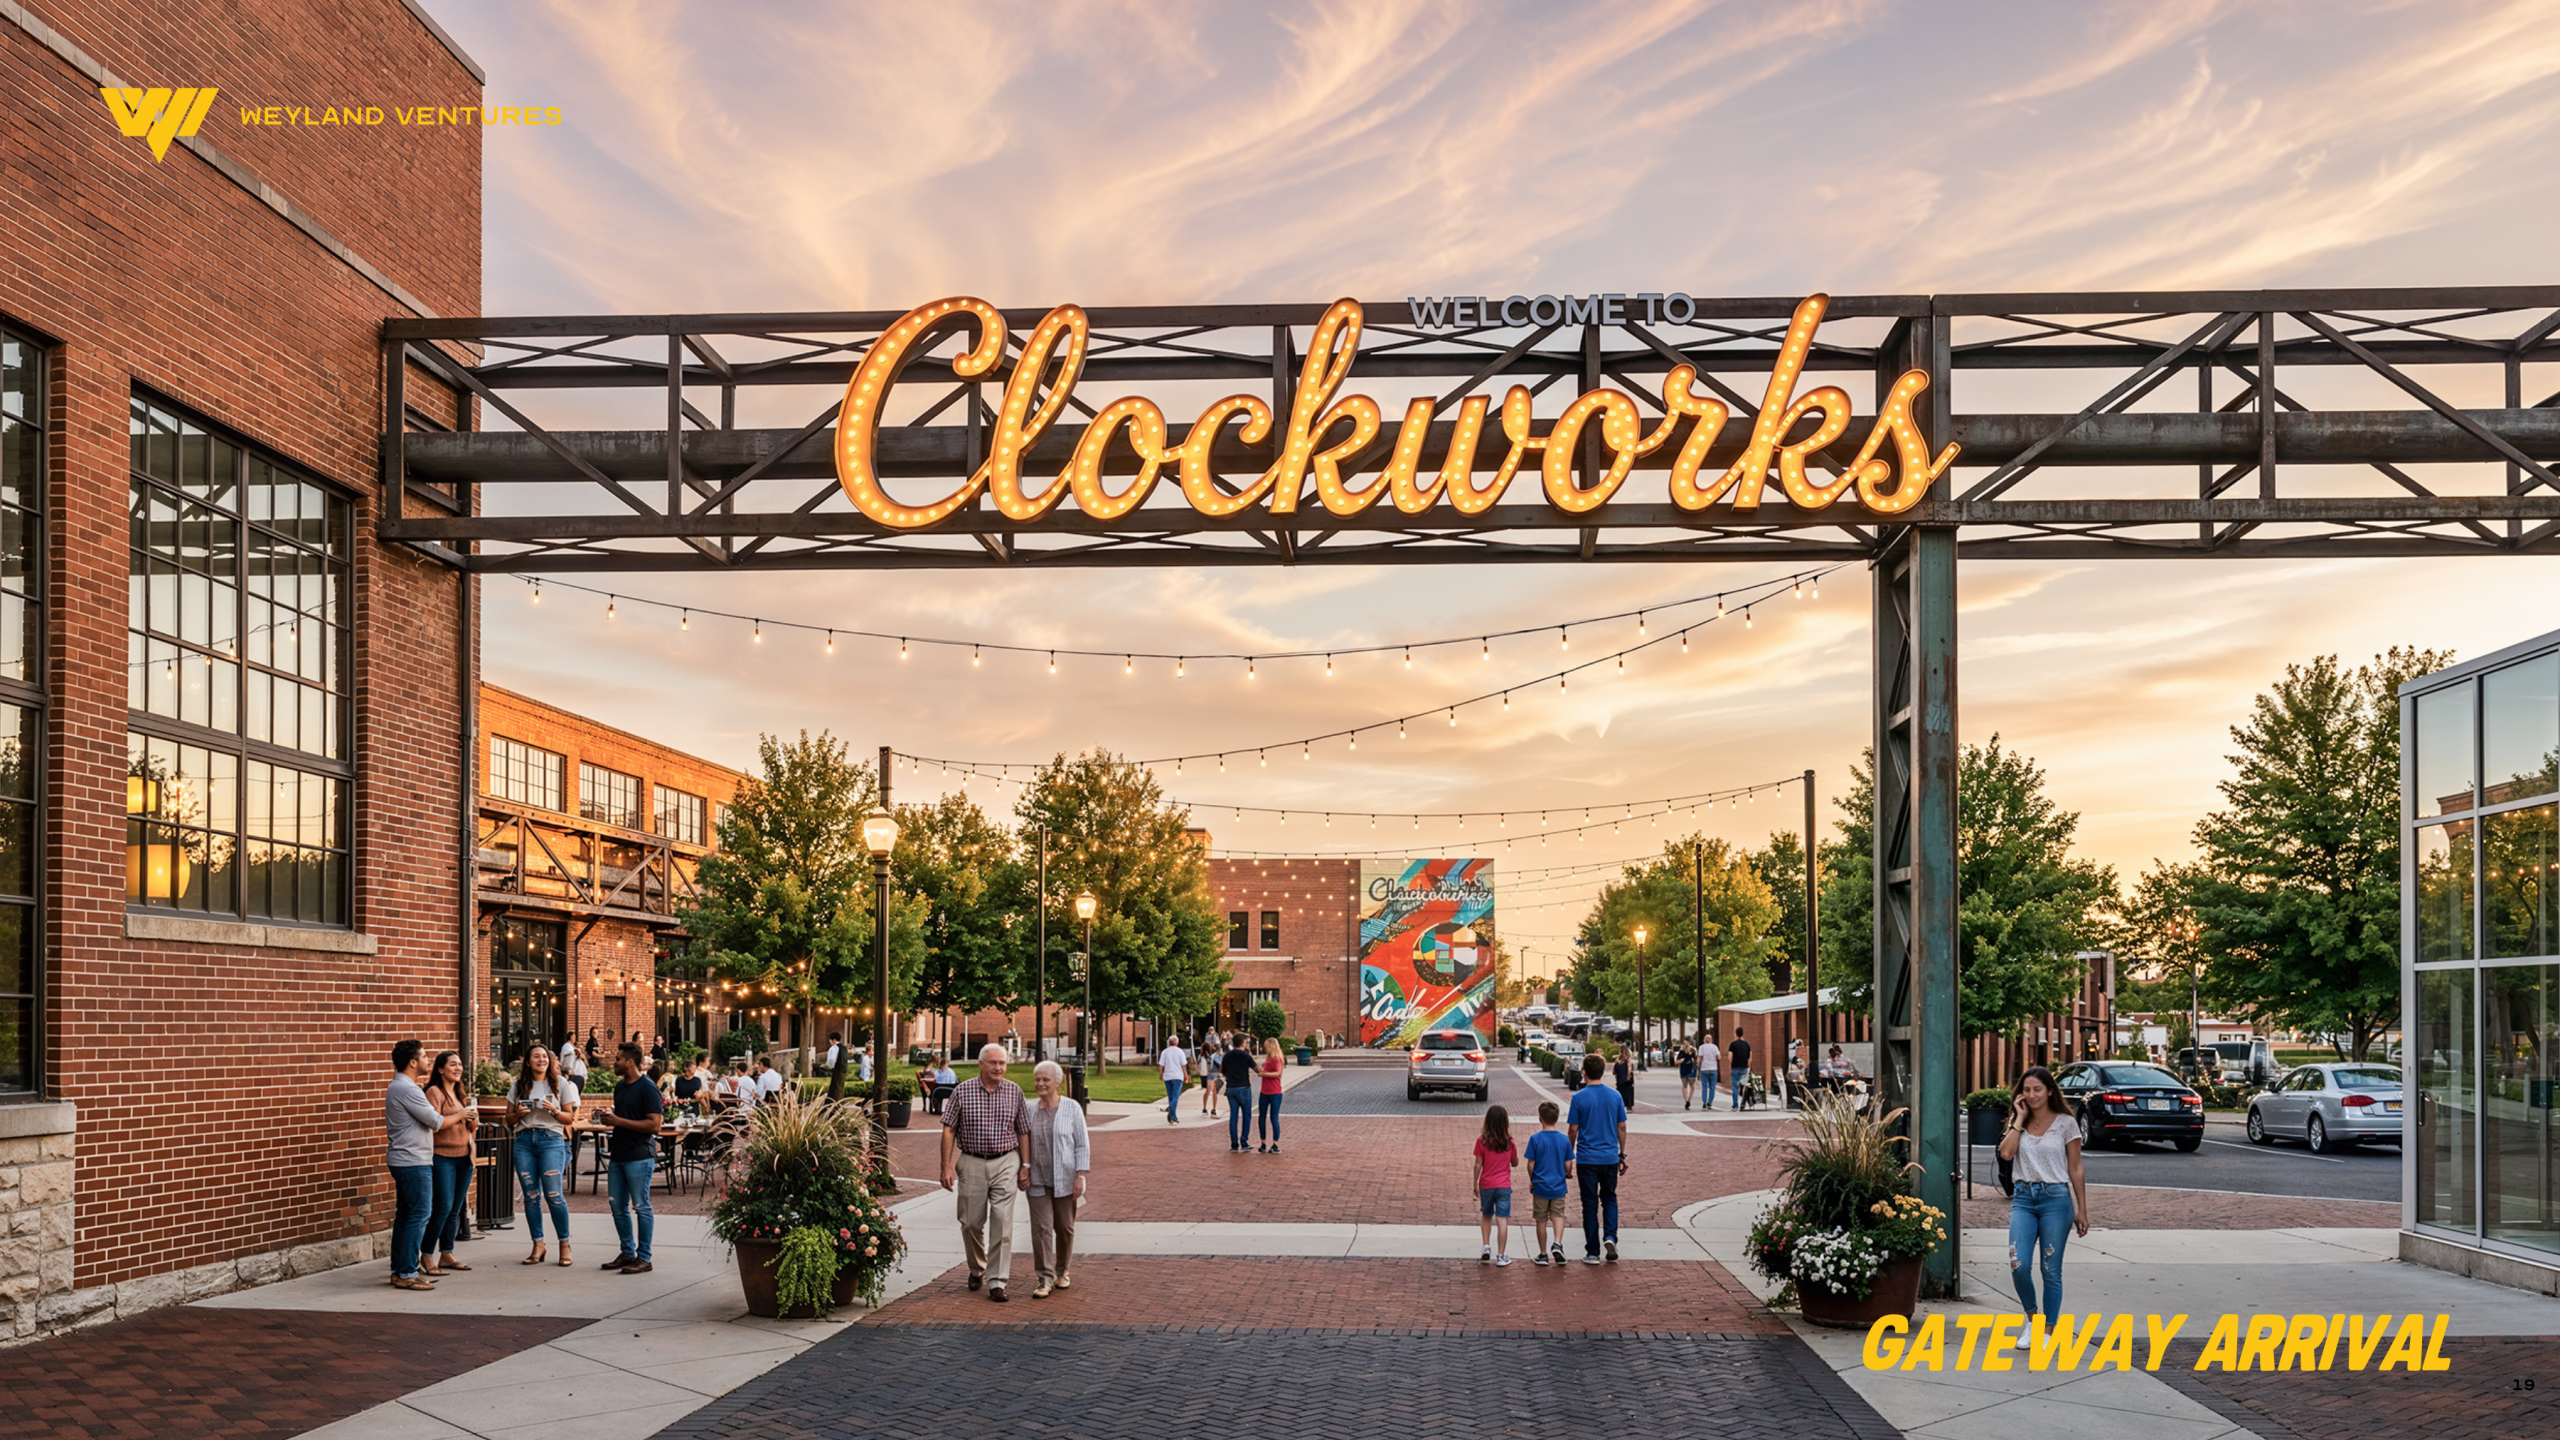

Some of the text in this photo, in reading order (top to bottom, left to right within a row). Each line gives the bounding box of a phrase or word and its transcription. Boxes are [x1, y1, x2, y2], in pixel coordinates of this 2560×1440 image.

[1407, 292, 1696, 329] WELCOME TO
[834, 292, 1962, 532] Clockworks
